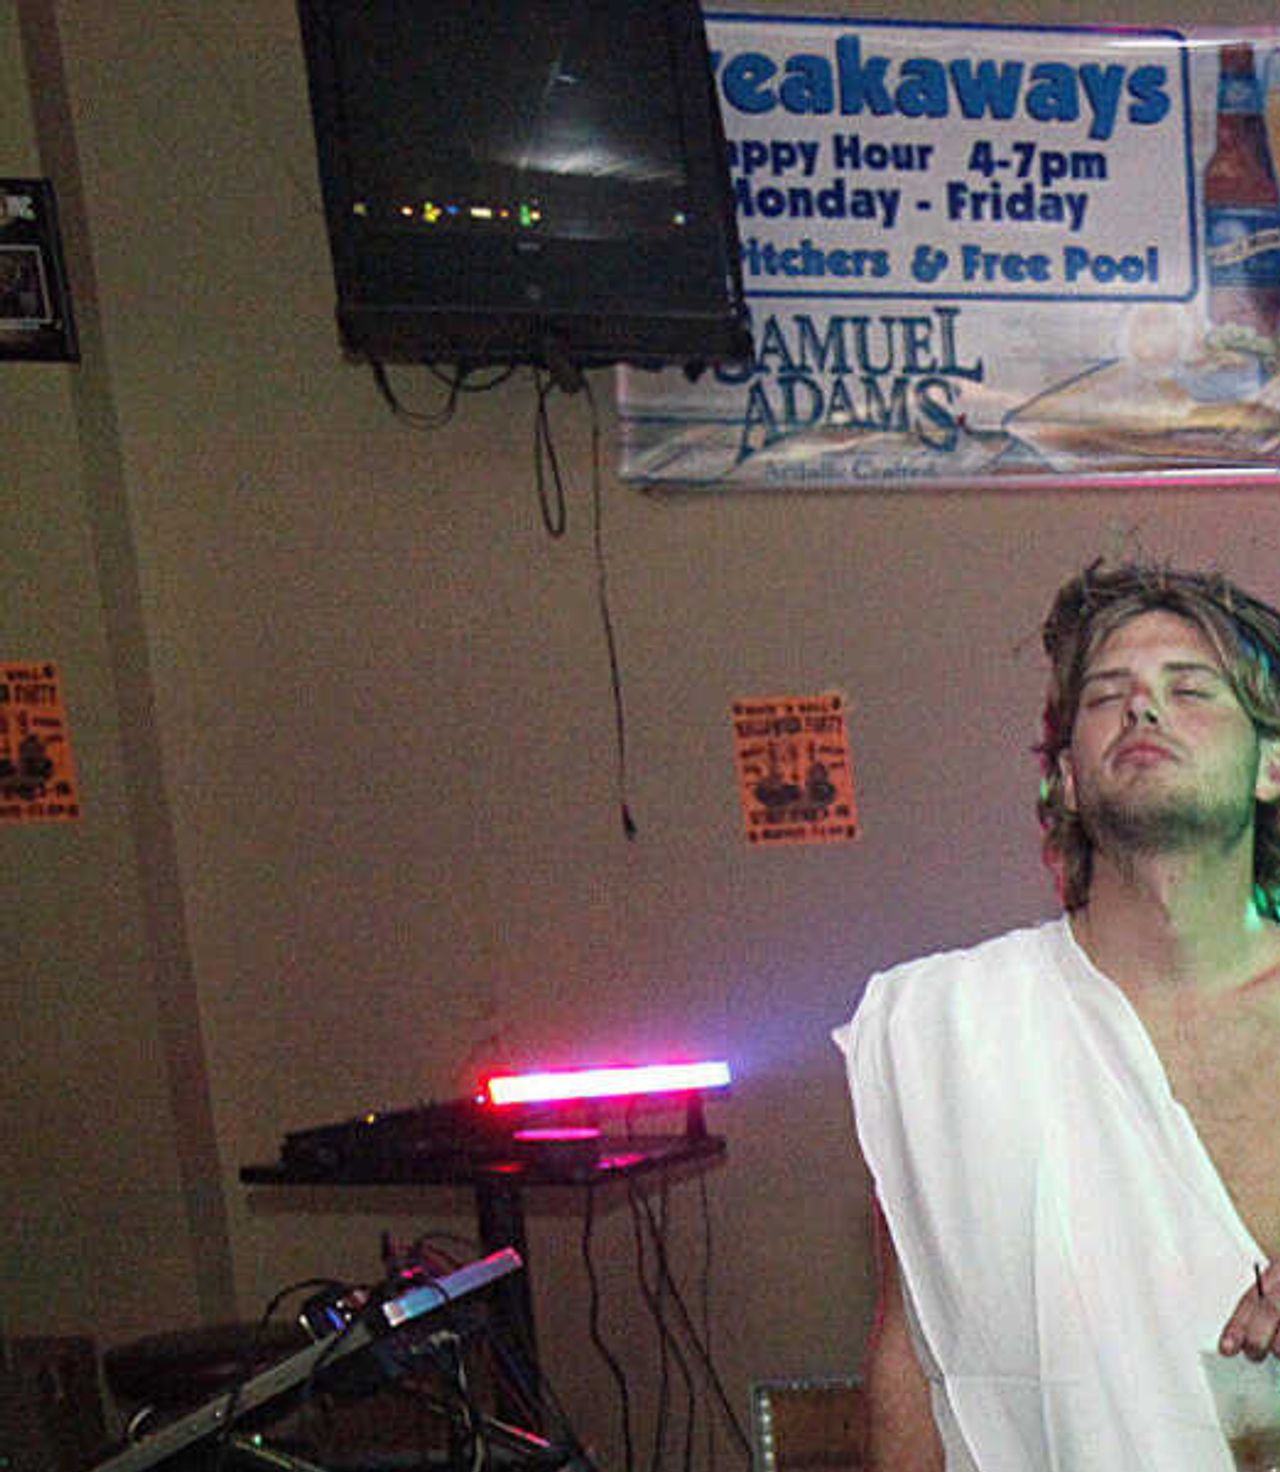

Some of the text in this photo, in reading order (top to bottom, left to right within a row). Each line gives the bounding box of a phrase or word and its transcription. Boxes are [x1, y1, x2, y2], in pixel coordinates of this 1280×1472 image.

[709, 34, 1172, 140] eakaways
[726, 133, 1109, 187] appy Hour 4-7pm
[946, 182, 1089, 232] Friday
[740, 237, 891, 278] itchers
[910, 243, 949, 283] &
[960, 244, 1055, 282] Free
[1063, 246, 1159, 283] Pool
[735, 376, 962, 465] ADAMS
